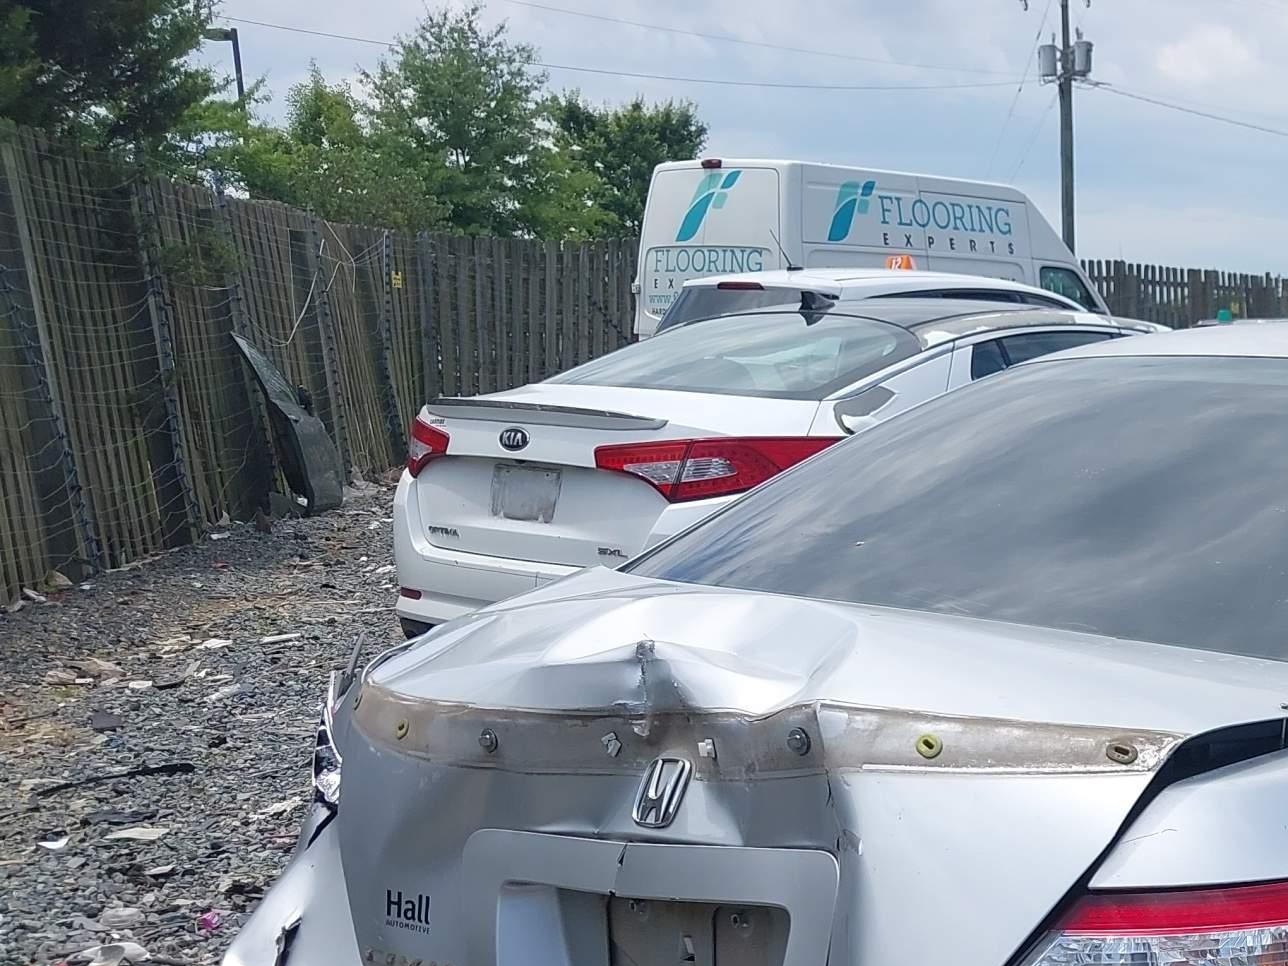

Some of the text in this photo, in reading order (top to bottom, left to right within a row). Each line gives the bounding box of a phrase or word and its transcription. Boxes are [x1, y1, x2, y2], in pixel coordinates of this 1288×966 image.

[878, 195, 1012, 235] FLOORING
[882, 232, 1015, 255] EXPERTS
[654, 249, 763, 273] FLOORING
[501, 431, 524, 446] KIA
[386, 889, 431, 925] Hall
[386, 919, 431, 935] AUTOMOTIVE
